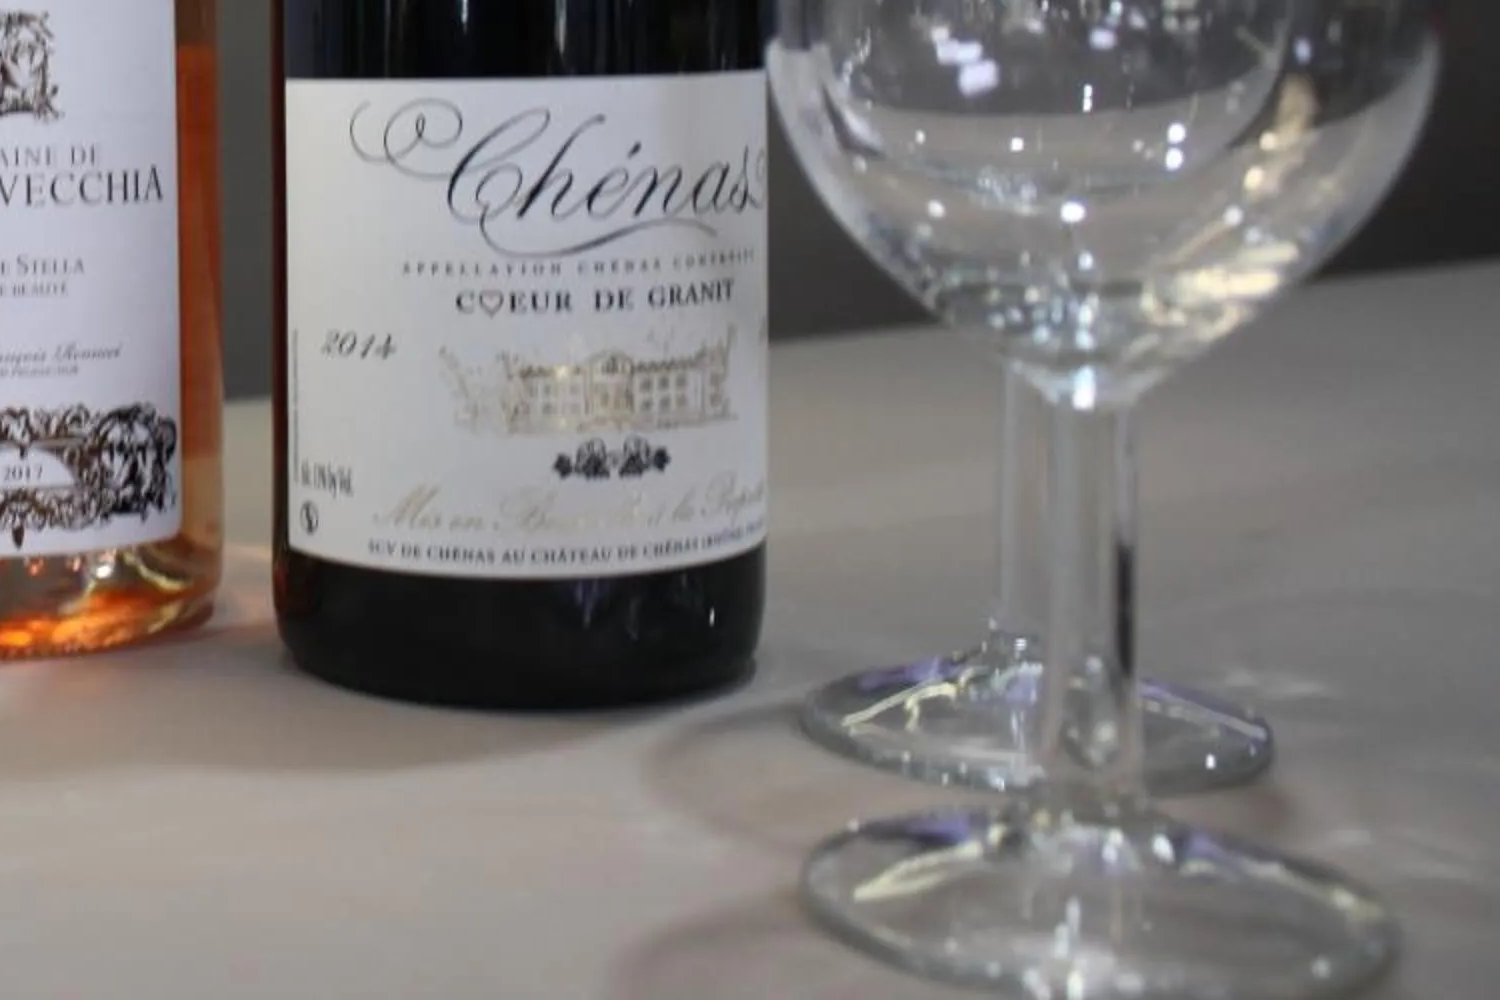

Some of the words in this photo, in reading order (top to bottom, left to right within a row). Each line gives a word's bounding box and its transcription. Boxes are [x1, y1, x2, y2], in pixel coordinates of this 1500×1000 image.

[70, 143, 101, 168] DE
[349, 97, 767, 259] Chénas
[594, 286, 635, 313] DE
[646, 277, 736, 308] GRANIT
[320, 329, 398, 361] 2014
[2, 463, 44, 482] 2017
[401, 542, 421, 560] DE
[501, 546, 526, 566] AU
[617, 546, 638, 561] DE
